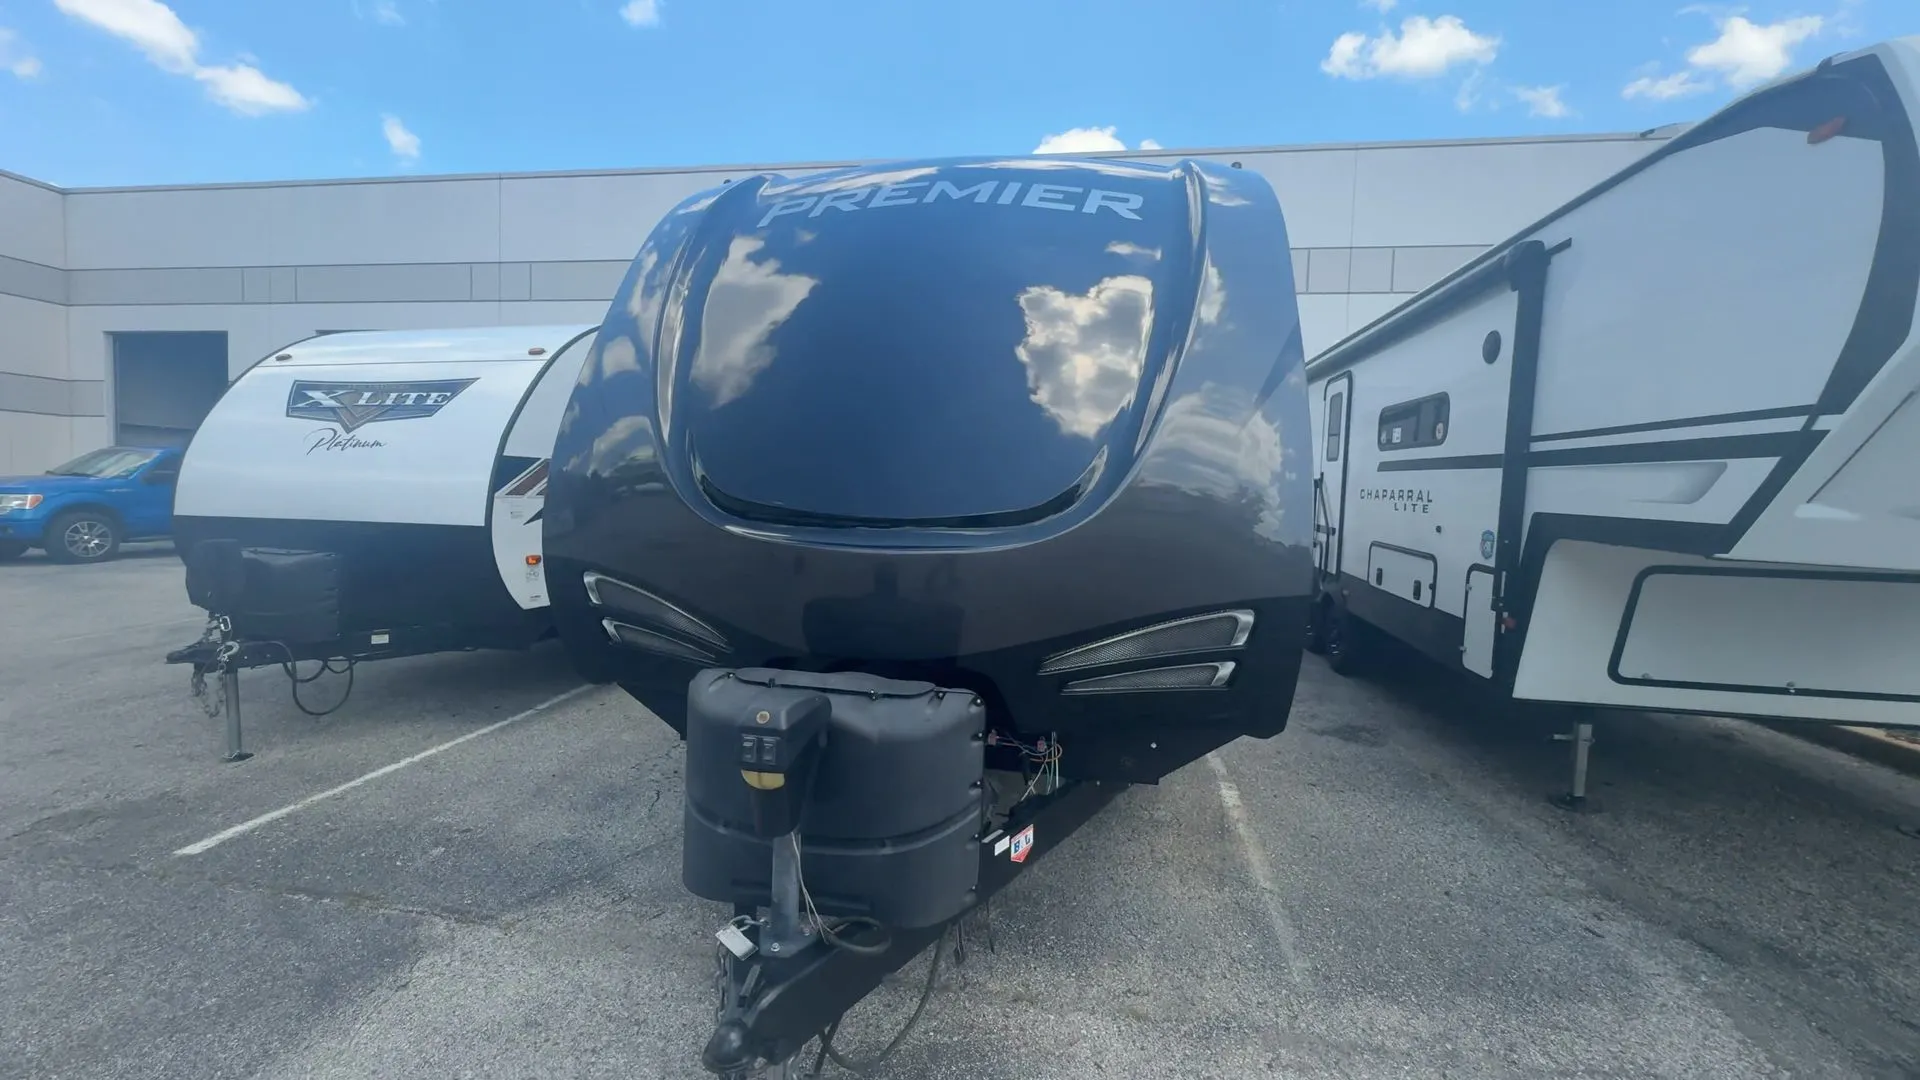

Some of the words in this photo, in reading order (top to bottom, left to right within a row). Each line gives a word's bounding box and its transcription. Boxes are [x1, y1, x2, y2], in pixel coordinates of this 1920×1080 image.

[756, 181, 1144, 229] PREMIER
[295, 391, 354, 407] X
[354, 391, 452, 406] LITE
[303, 427, 387, 455] Platinum
[1360, 489, 1433, 503] CHAPARRAL
[1394, 502, 1430, 514] LITE
